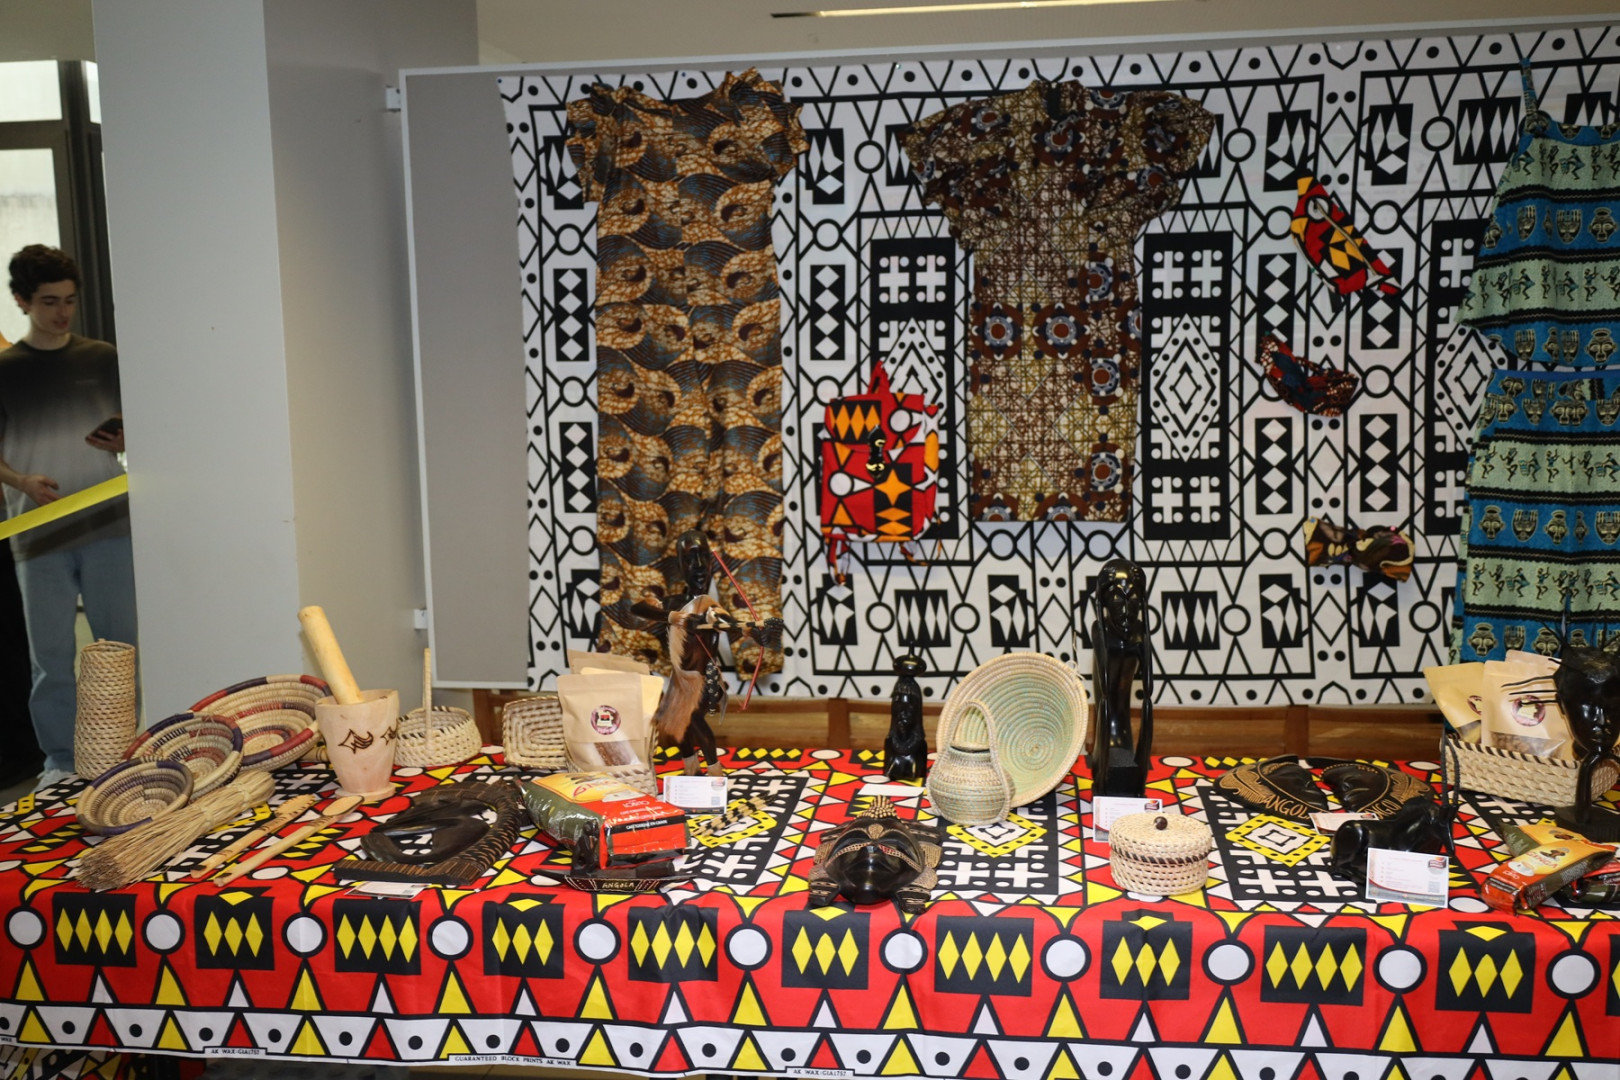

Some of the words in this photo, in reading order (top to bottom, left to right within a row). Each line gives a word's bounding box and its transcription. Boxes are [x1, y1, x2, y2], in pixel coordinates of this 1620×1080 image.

[1260, 795, 1311, 819] ANGOL
[1526, 851, 1558, 868] GINGA
[602, 881, 635, 889] ANGOLA
